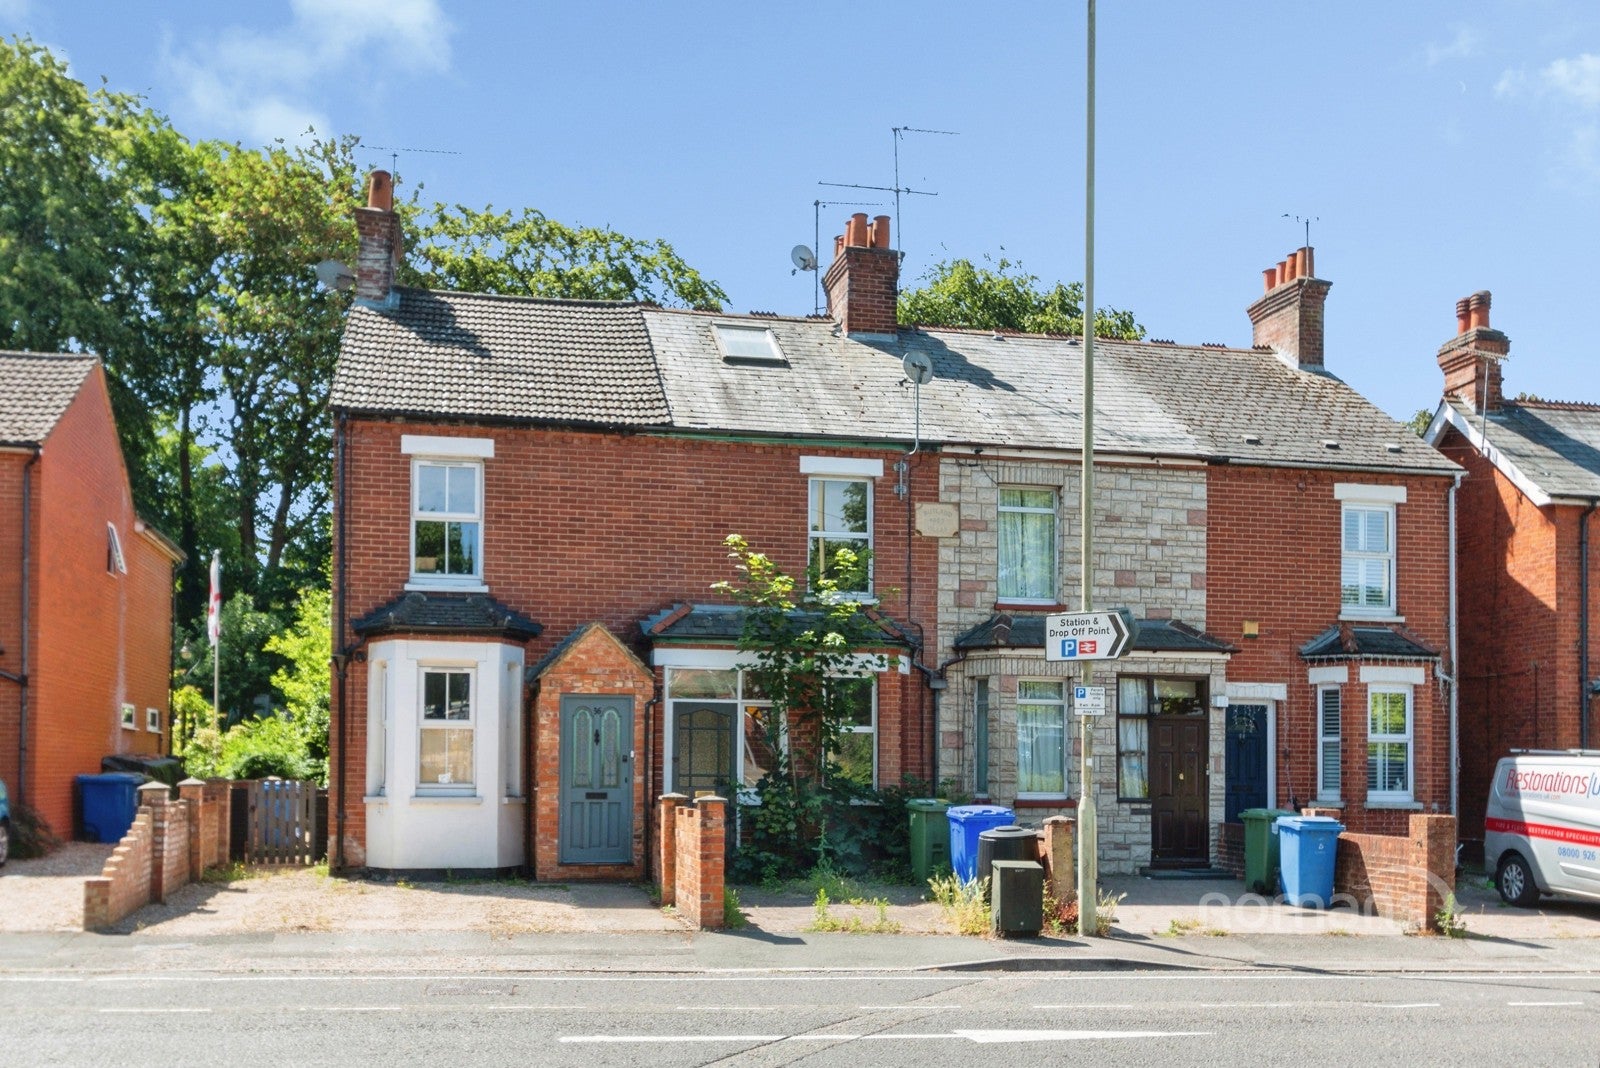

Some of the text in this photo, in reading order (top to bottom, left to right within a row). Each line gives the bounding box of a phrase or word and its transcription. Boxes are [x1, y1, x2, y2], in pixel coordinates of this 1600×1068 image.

[1060, 617, 1099, 627] Station &
[1049, 627, 1110, 638] Drop Off Point
[1065, 641, 1075, 656] P
[1528, 827, 1564, 838] RESTORATION
[1565, 831, 1600, 844] SPECIALIST
[1558, 846, 1579, 859] 08000
